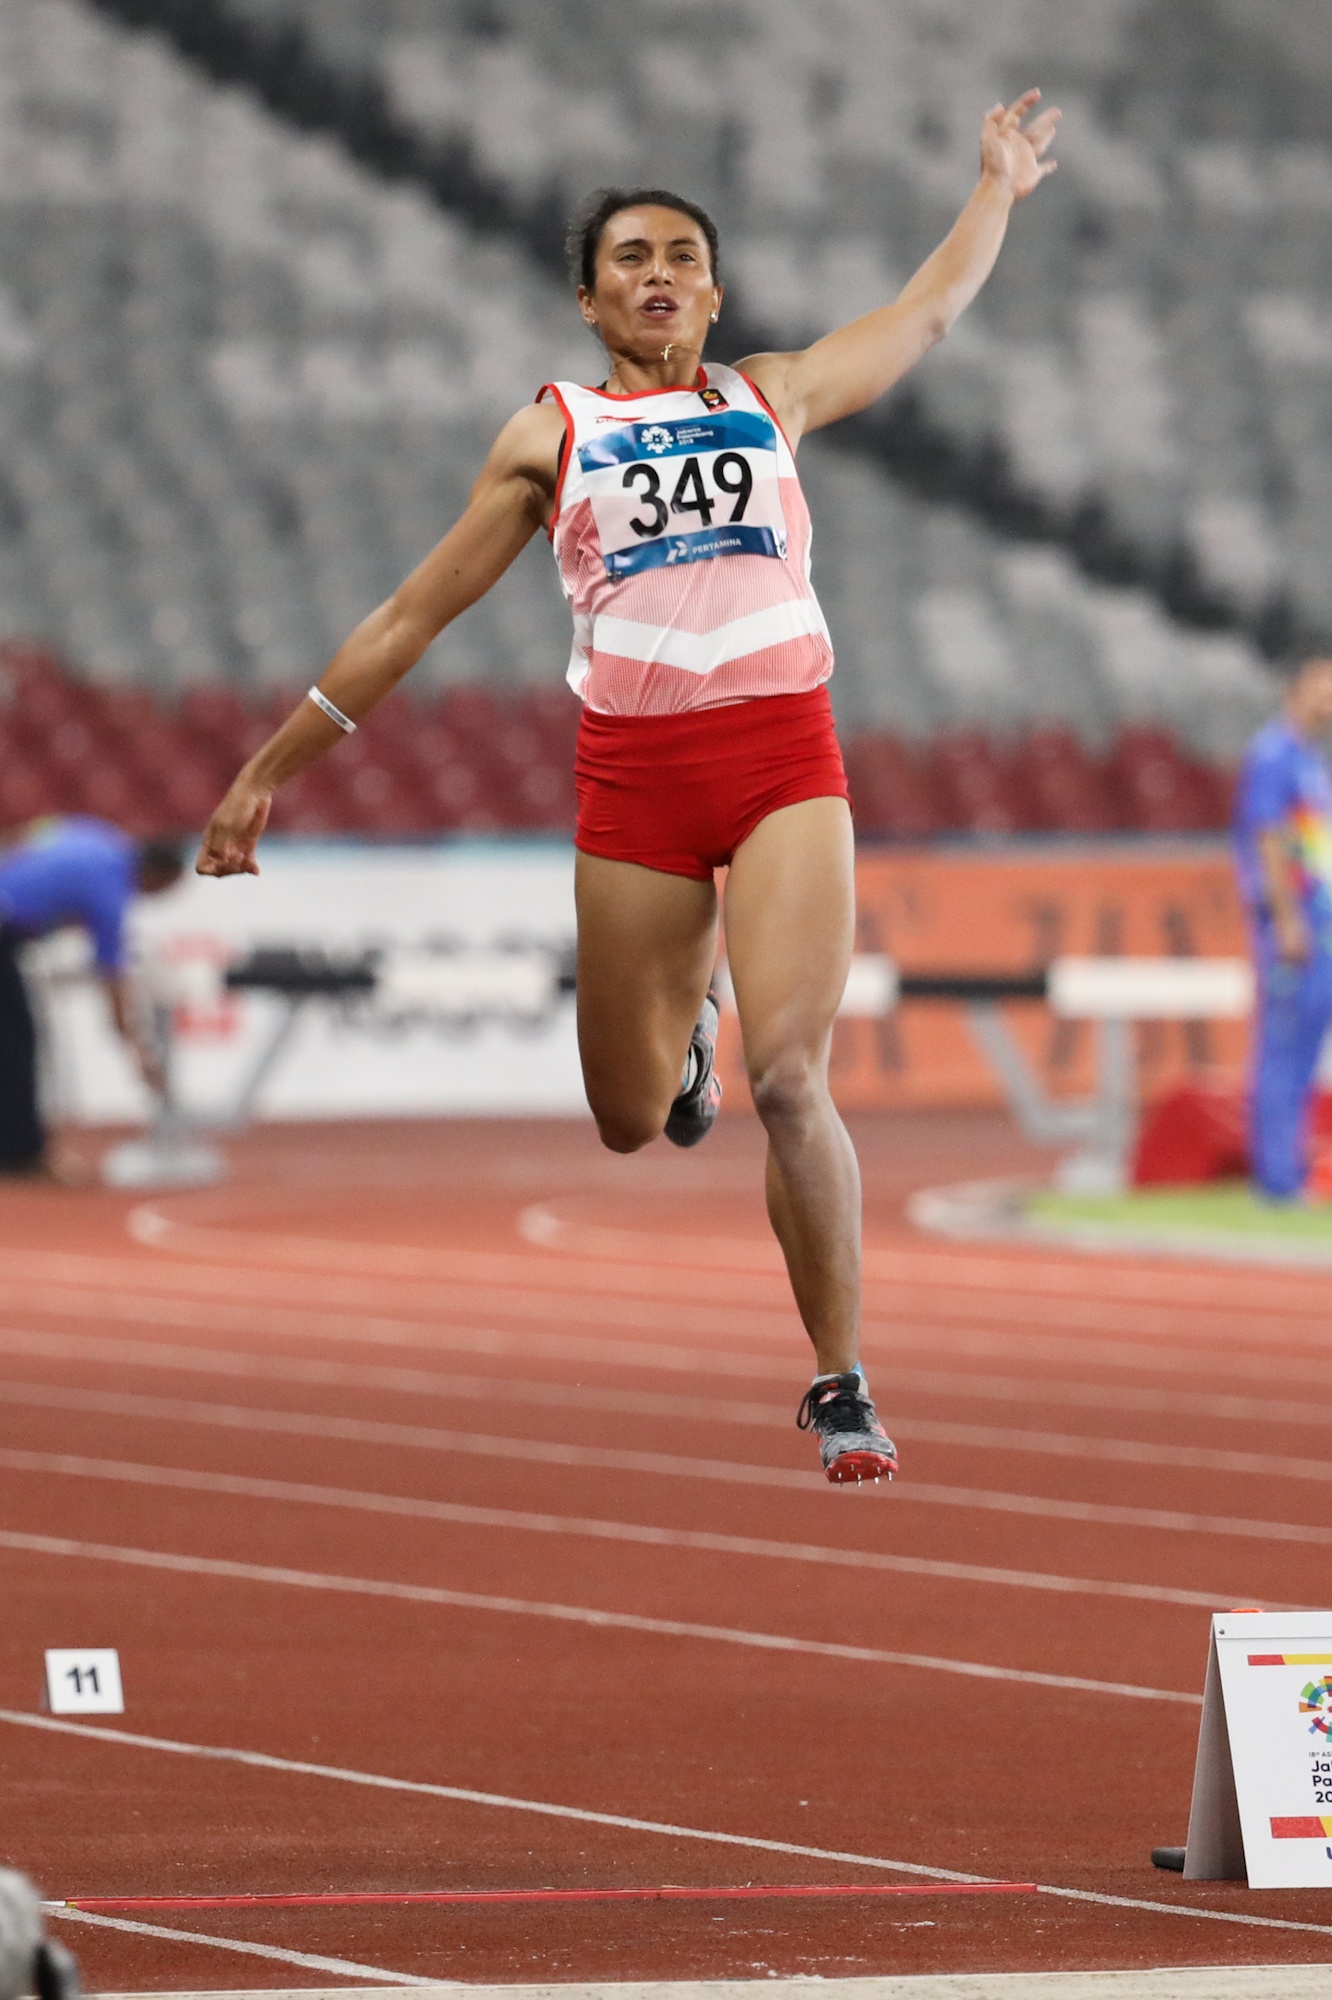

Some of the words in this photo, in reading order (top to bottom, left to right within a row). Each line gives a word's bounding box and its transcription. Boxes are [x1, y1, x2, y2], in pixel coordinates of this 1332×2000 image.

[622, 452, 752, 538] 349
[692, 538, 742, 554] PERTAMINA
[66, 1666, 99, 1694] 11
[1311, 1760, 1332, 1773] Ja
